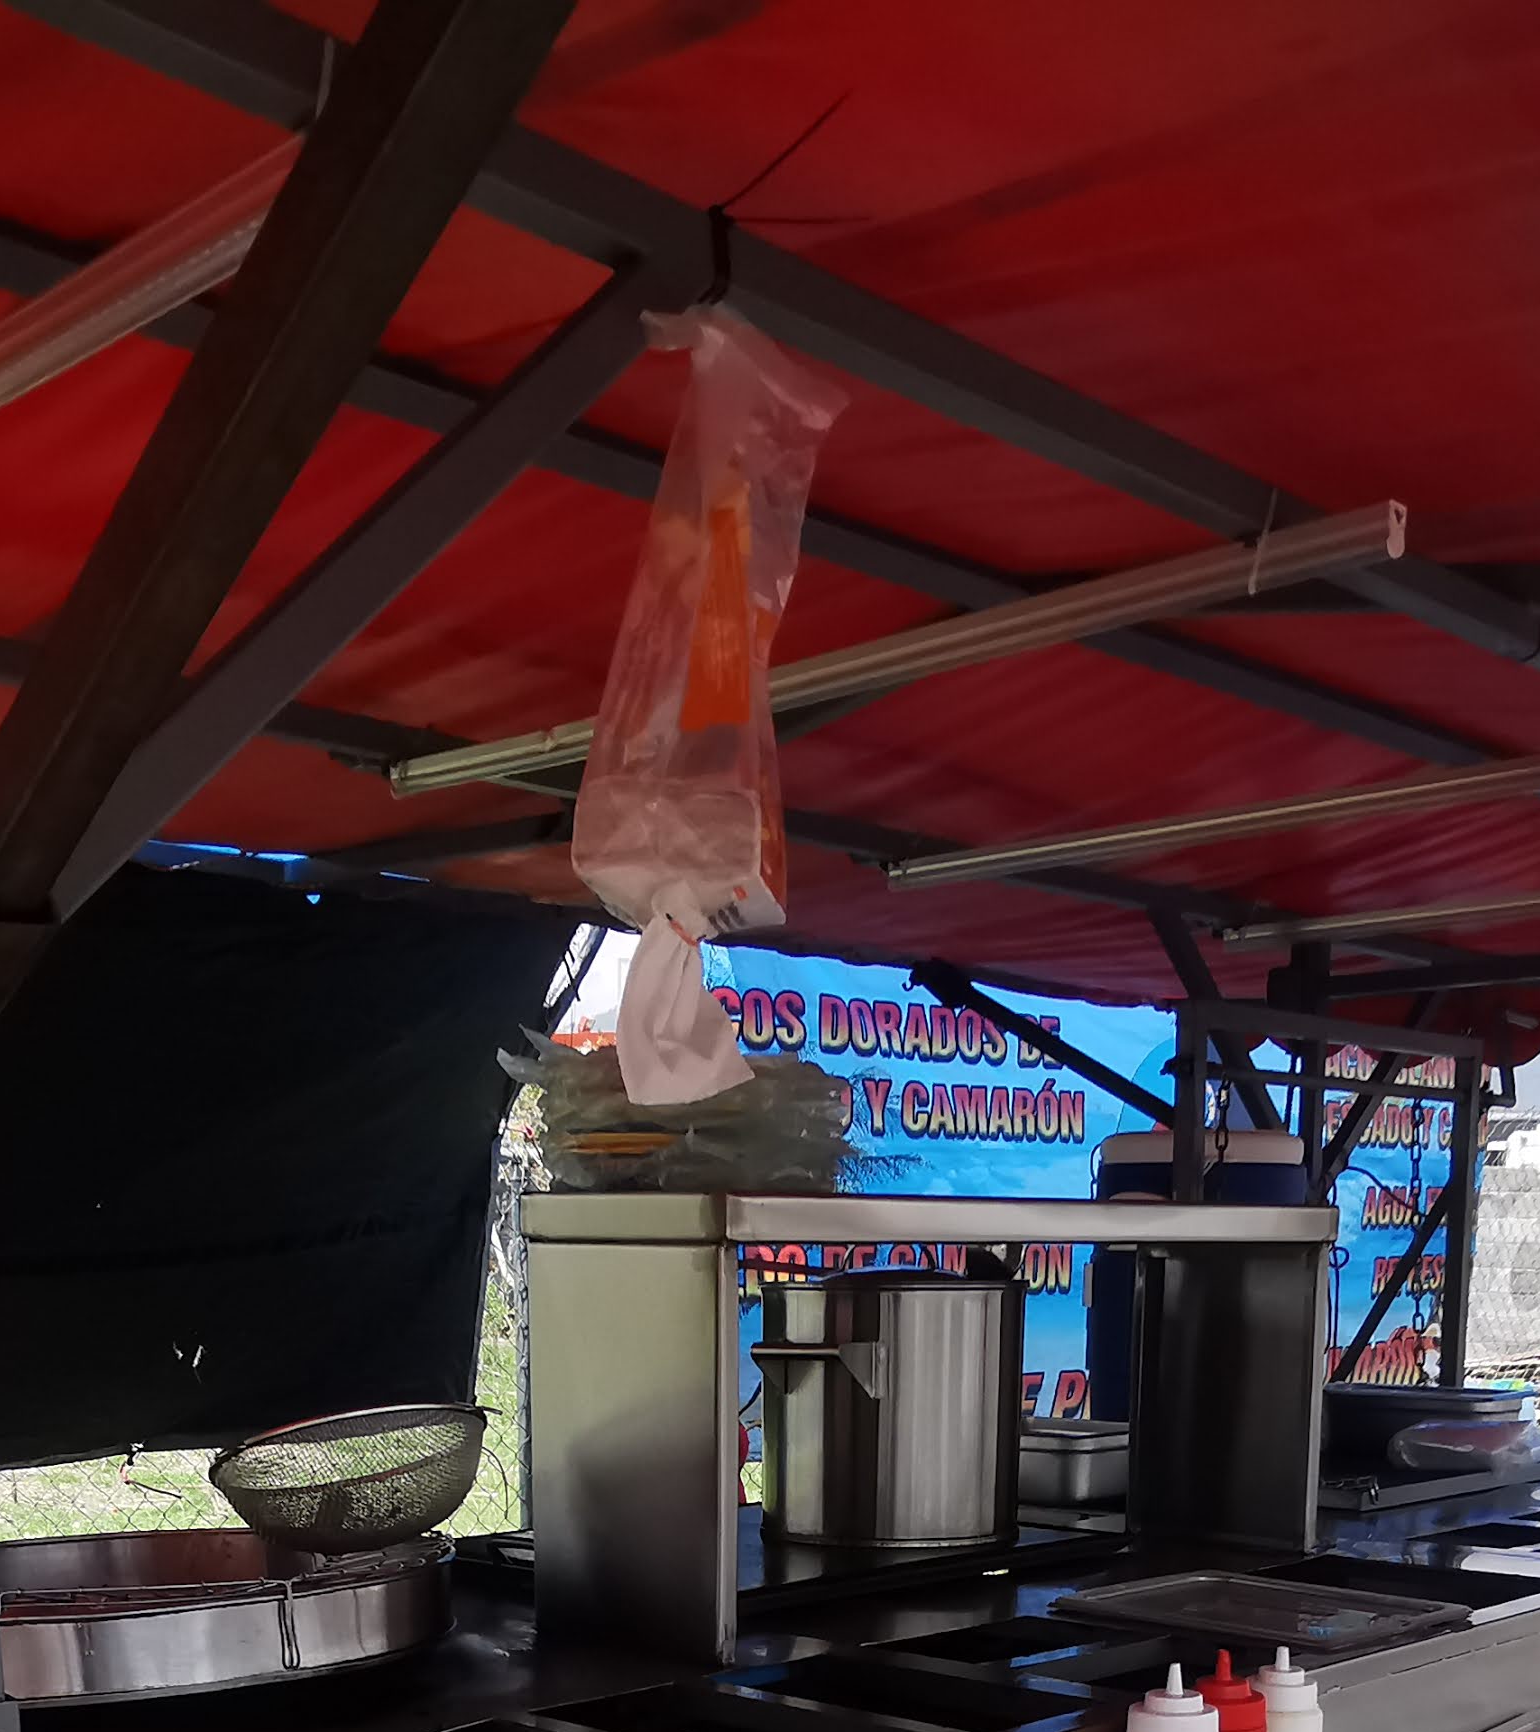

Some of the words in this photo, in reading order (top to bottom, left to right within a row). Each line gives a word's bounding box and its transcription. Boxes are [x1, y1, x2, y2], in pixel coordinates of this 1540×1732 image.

[711, 986, 806, 1052] COS
[819, 993, 1007, 1064] DORADOS
[862, 1079, 892, 1137] Y
[902, 1078, 1085, 1144] CAMARÓN
